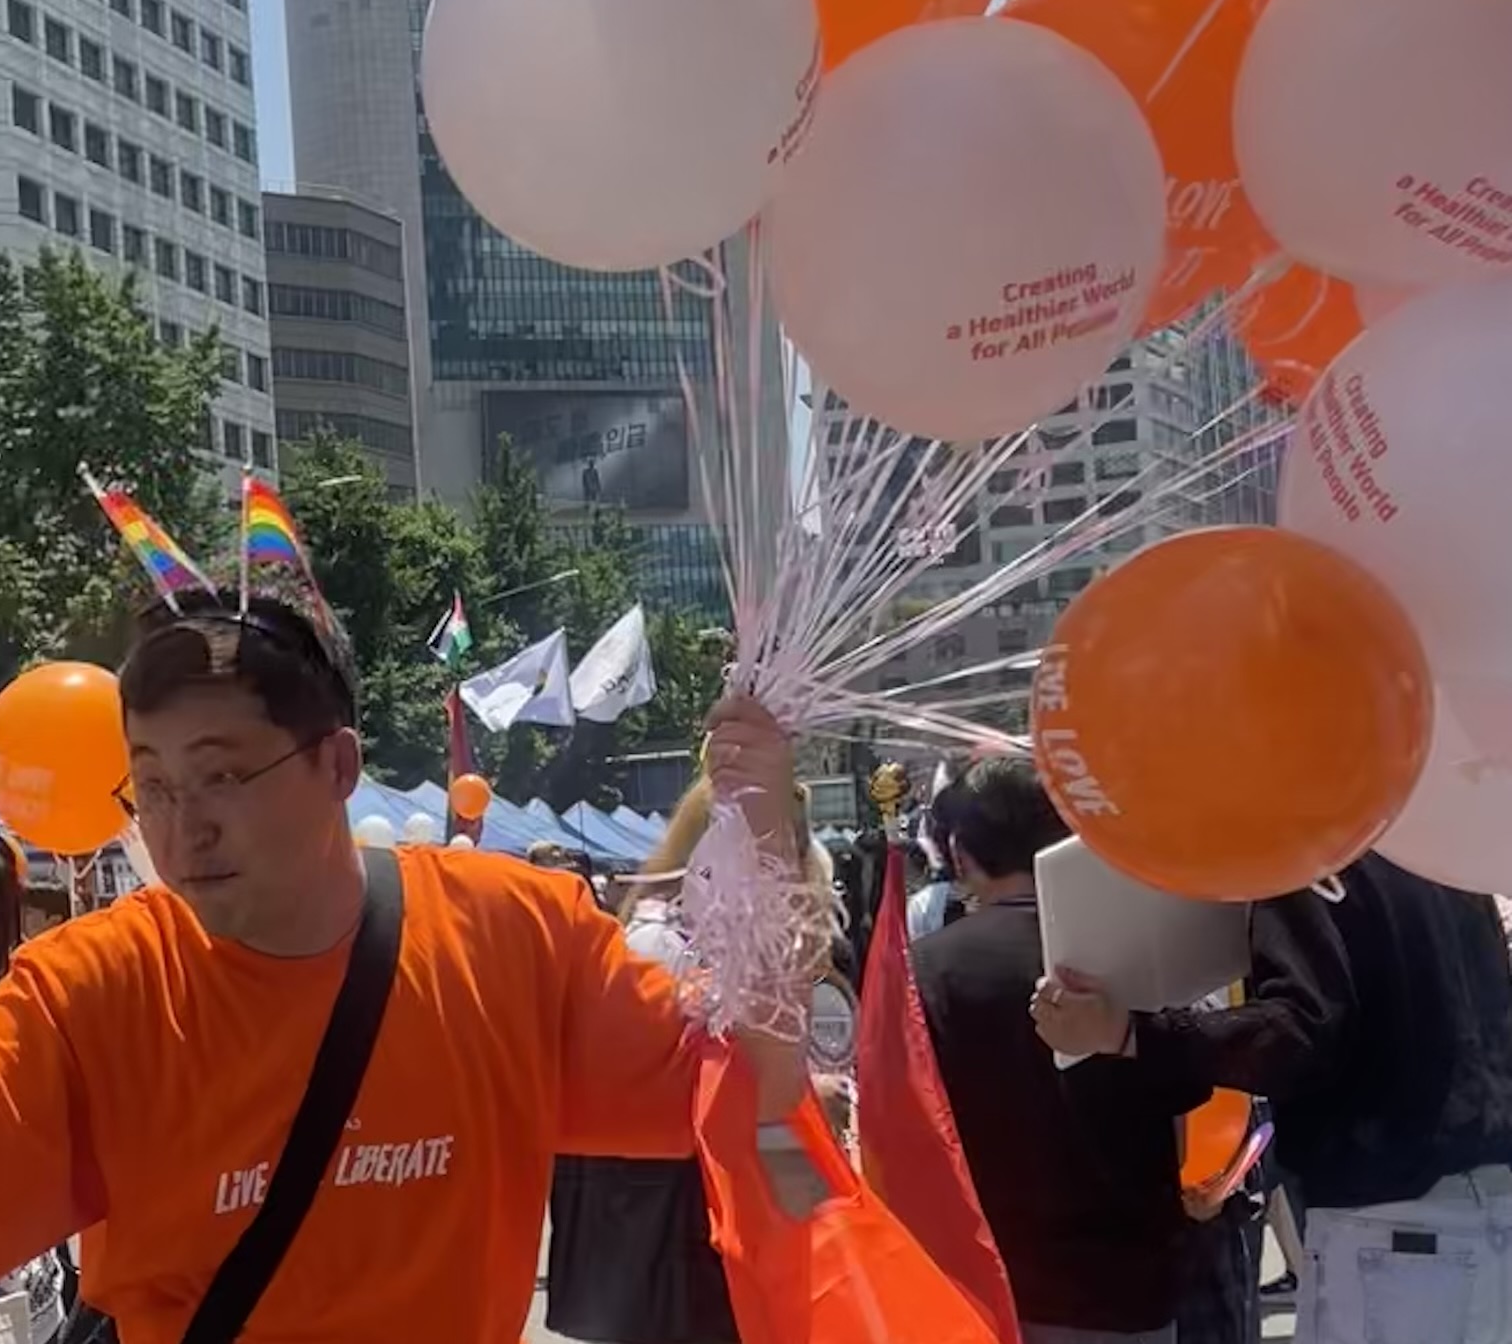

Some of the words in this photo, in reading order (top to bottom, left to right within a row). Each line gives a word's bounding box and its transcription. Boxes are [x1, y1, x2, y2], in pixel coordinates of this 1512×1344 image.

[1394, 202, 1432, 227] for
[1002, 262, 1097, 303] Creating
[946, 325, 962, 340] a
[969, 296, 1078, 337] Healthier
[971, 340, 1011, 361] for
[1014, 330, 1046, 354] All
[1345, 374, 1387, 459] Creating
[1316, 443, 1360, 522] People
[1349, 453, 1399, 523] World
[1042, 729, 1121, 815] LOVE
